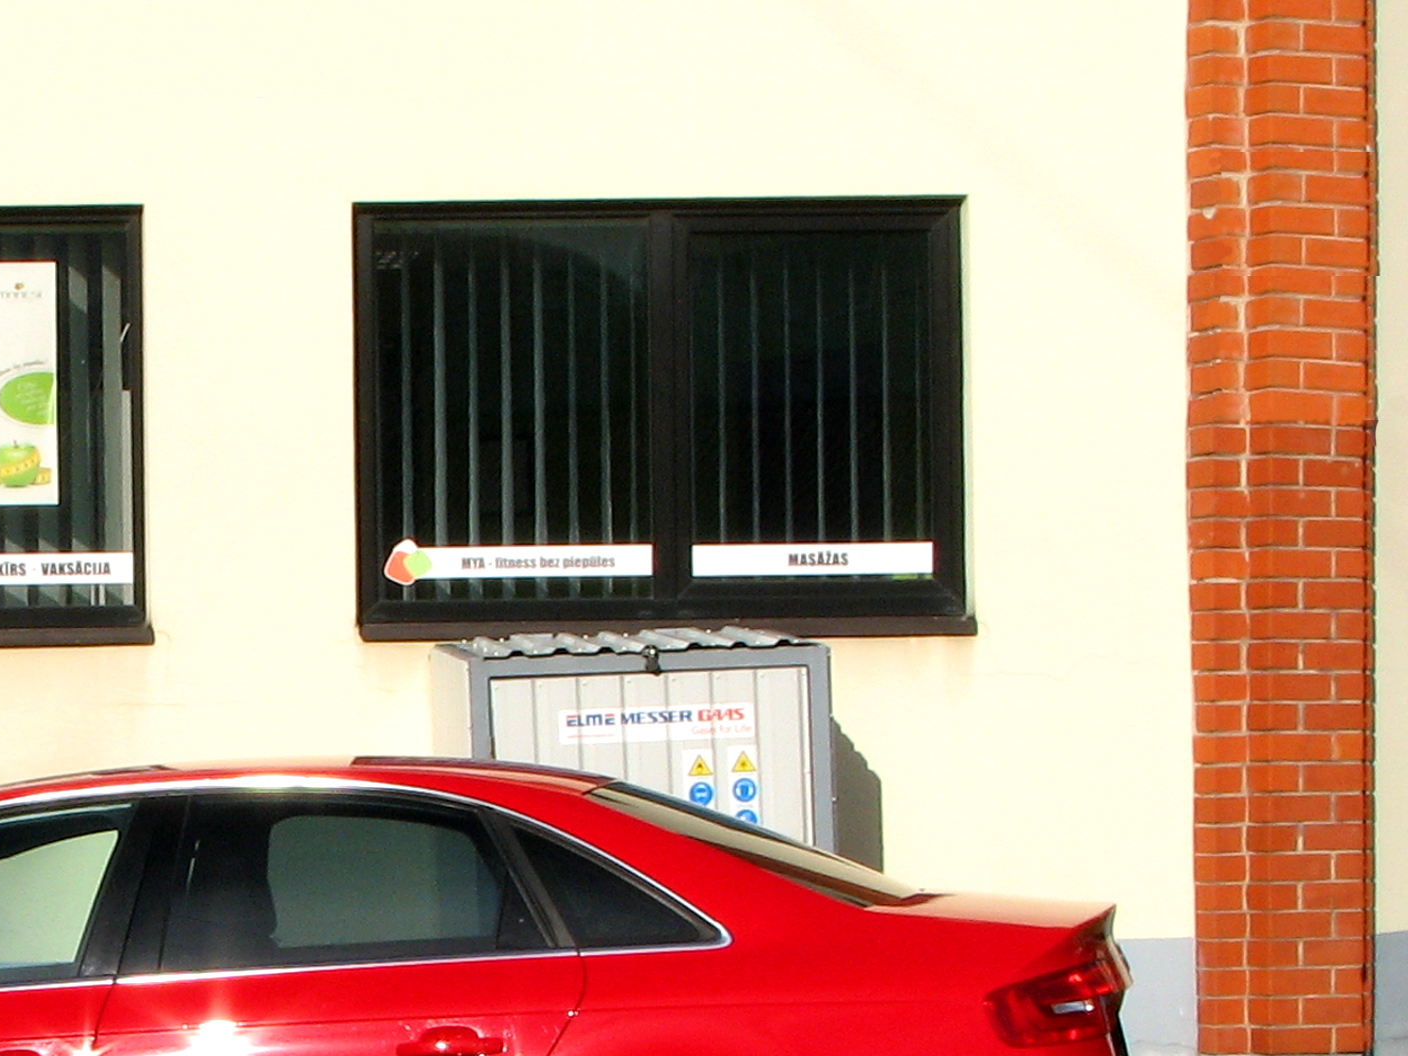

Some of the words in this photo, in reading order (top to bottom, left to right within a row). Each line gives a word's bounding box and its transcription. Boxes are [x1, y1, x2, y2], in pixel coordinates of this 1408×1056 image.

[461, 557, 485, 569] MYA
[495, 557, 537, 569] fitness
[539, 556, 560, 568] bez
[563, 555, 615, 569] piepūles
[788, 550, 849, 566] MASĀŽAS
[41, 560, 111, 576] VAKSĀCIJA
[621, 710, 693, 725] MESSER
[698, 708, 745, 722] GAAS
